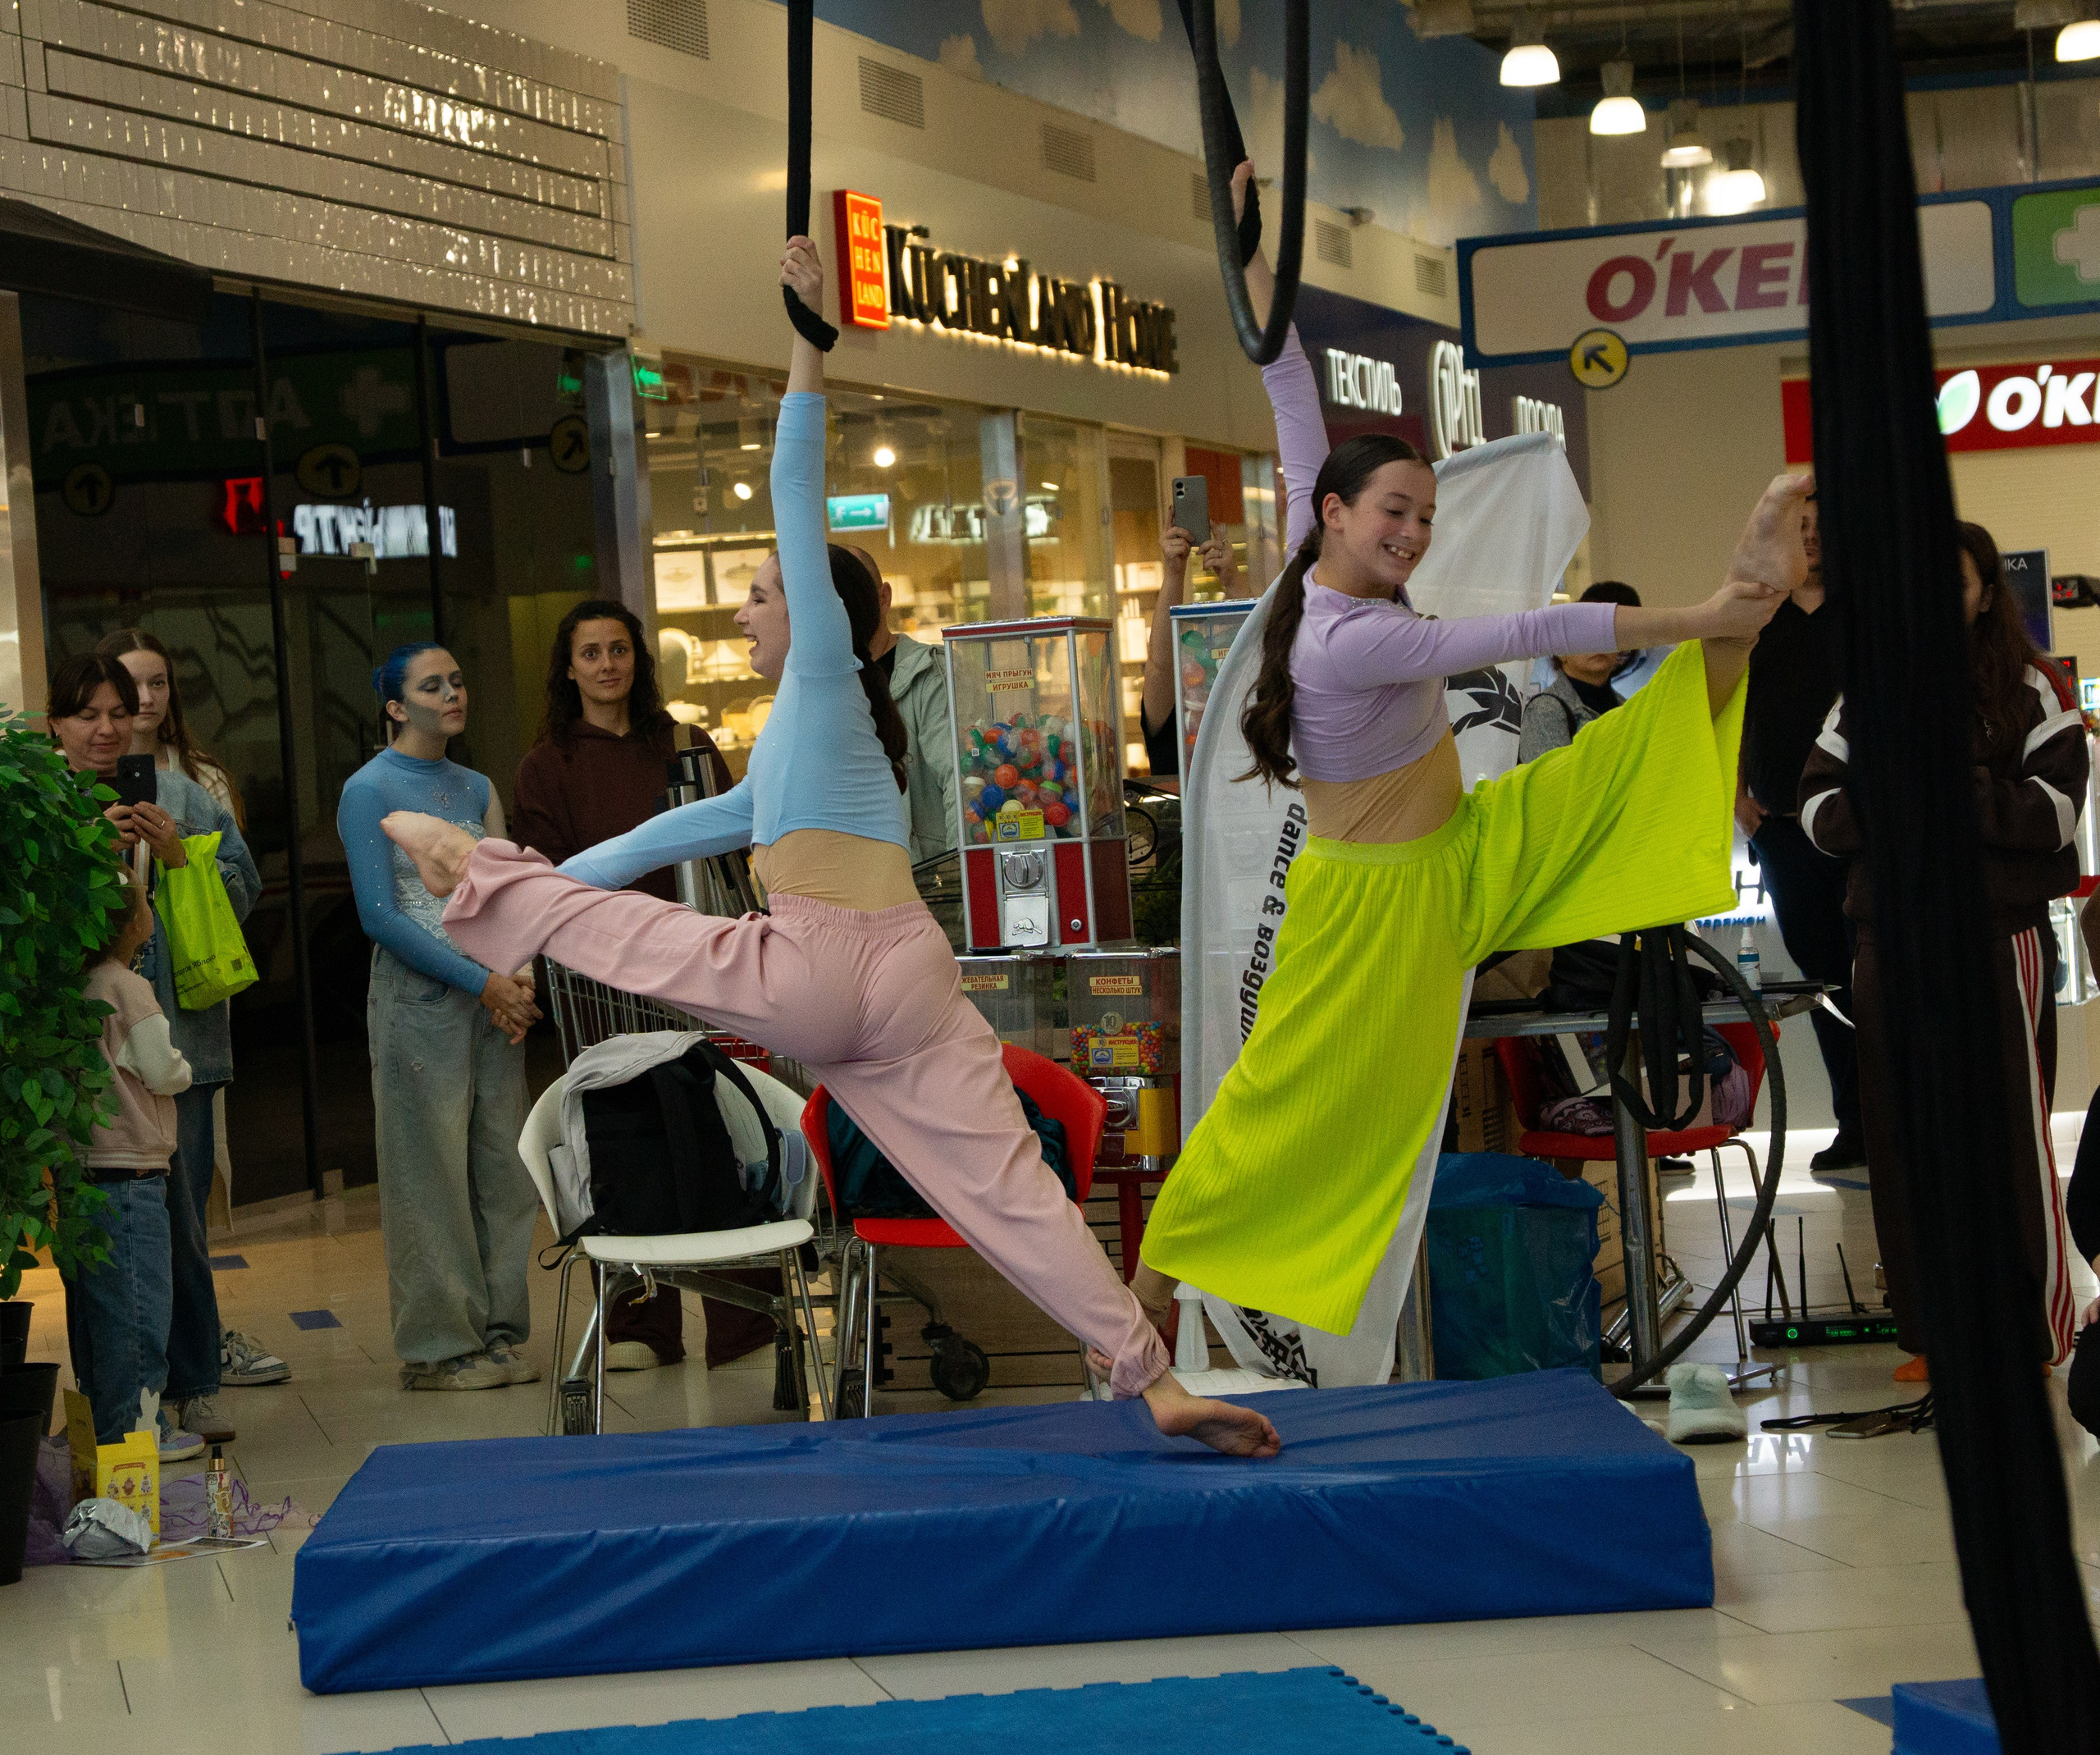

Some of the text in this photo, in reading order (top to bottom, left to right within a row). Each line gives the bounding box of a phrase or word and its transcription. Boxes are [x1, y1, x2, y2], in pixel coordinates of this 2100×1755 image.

[852, 210, 879, 241] KÜC
[854, 245, 881, 273] HEN
[1586, 238, 1810, 323] О'КЕ
[856, 280, 883, 309] LAND
[1326, 348, 1403, 416] ТЕКСТИЛЬ
[1987, 366, 2100, 432] О'К
[986, 670, 1032, 679] МЯЧ ПРЫГУН
[993, 681, 1029, 691] ИГРУШКА
[1270, 802, 1308, 889] dance
[1262, 895, 1285, 916] &
[962, 975, 1004, 984] ЖЕВАТЕЛЬНАЯ
[1092, 986, 1141, 994] НЕСКОЛЬКО ШТУК
[1096, 977, 1134, 985] КОНФЕТЫ
[1102, 1015, 1117, 1027] 10
